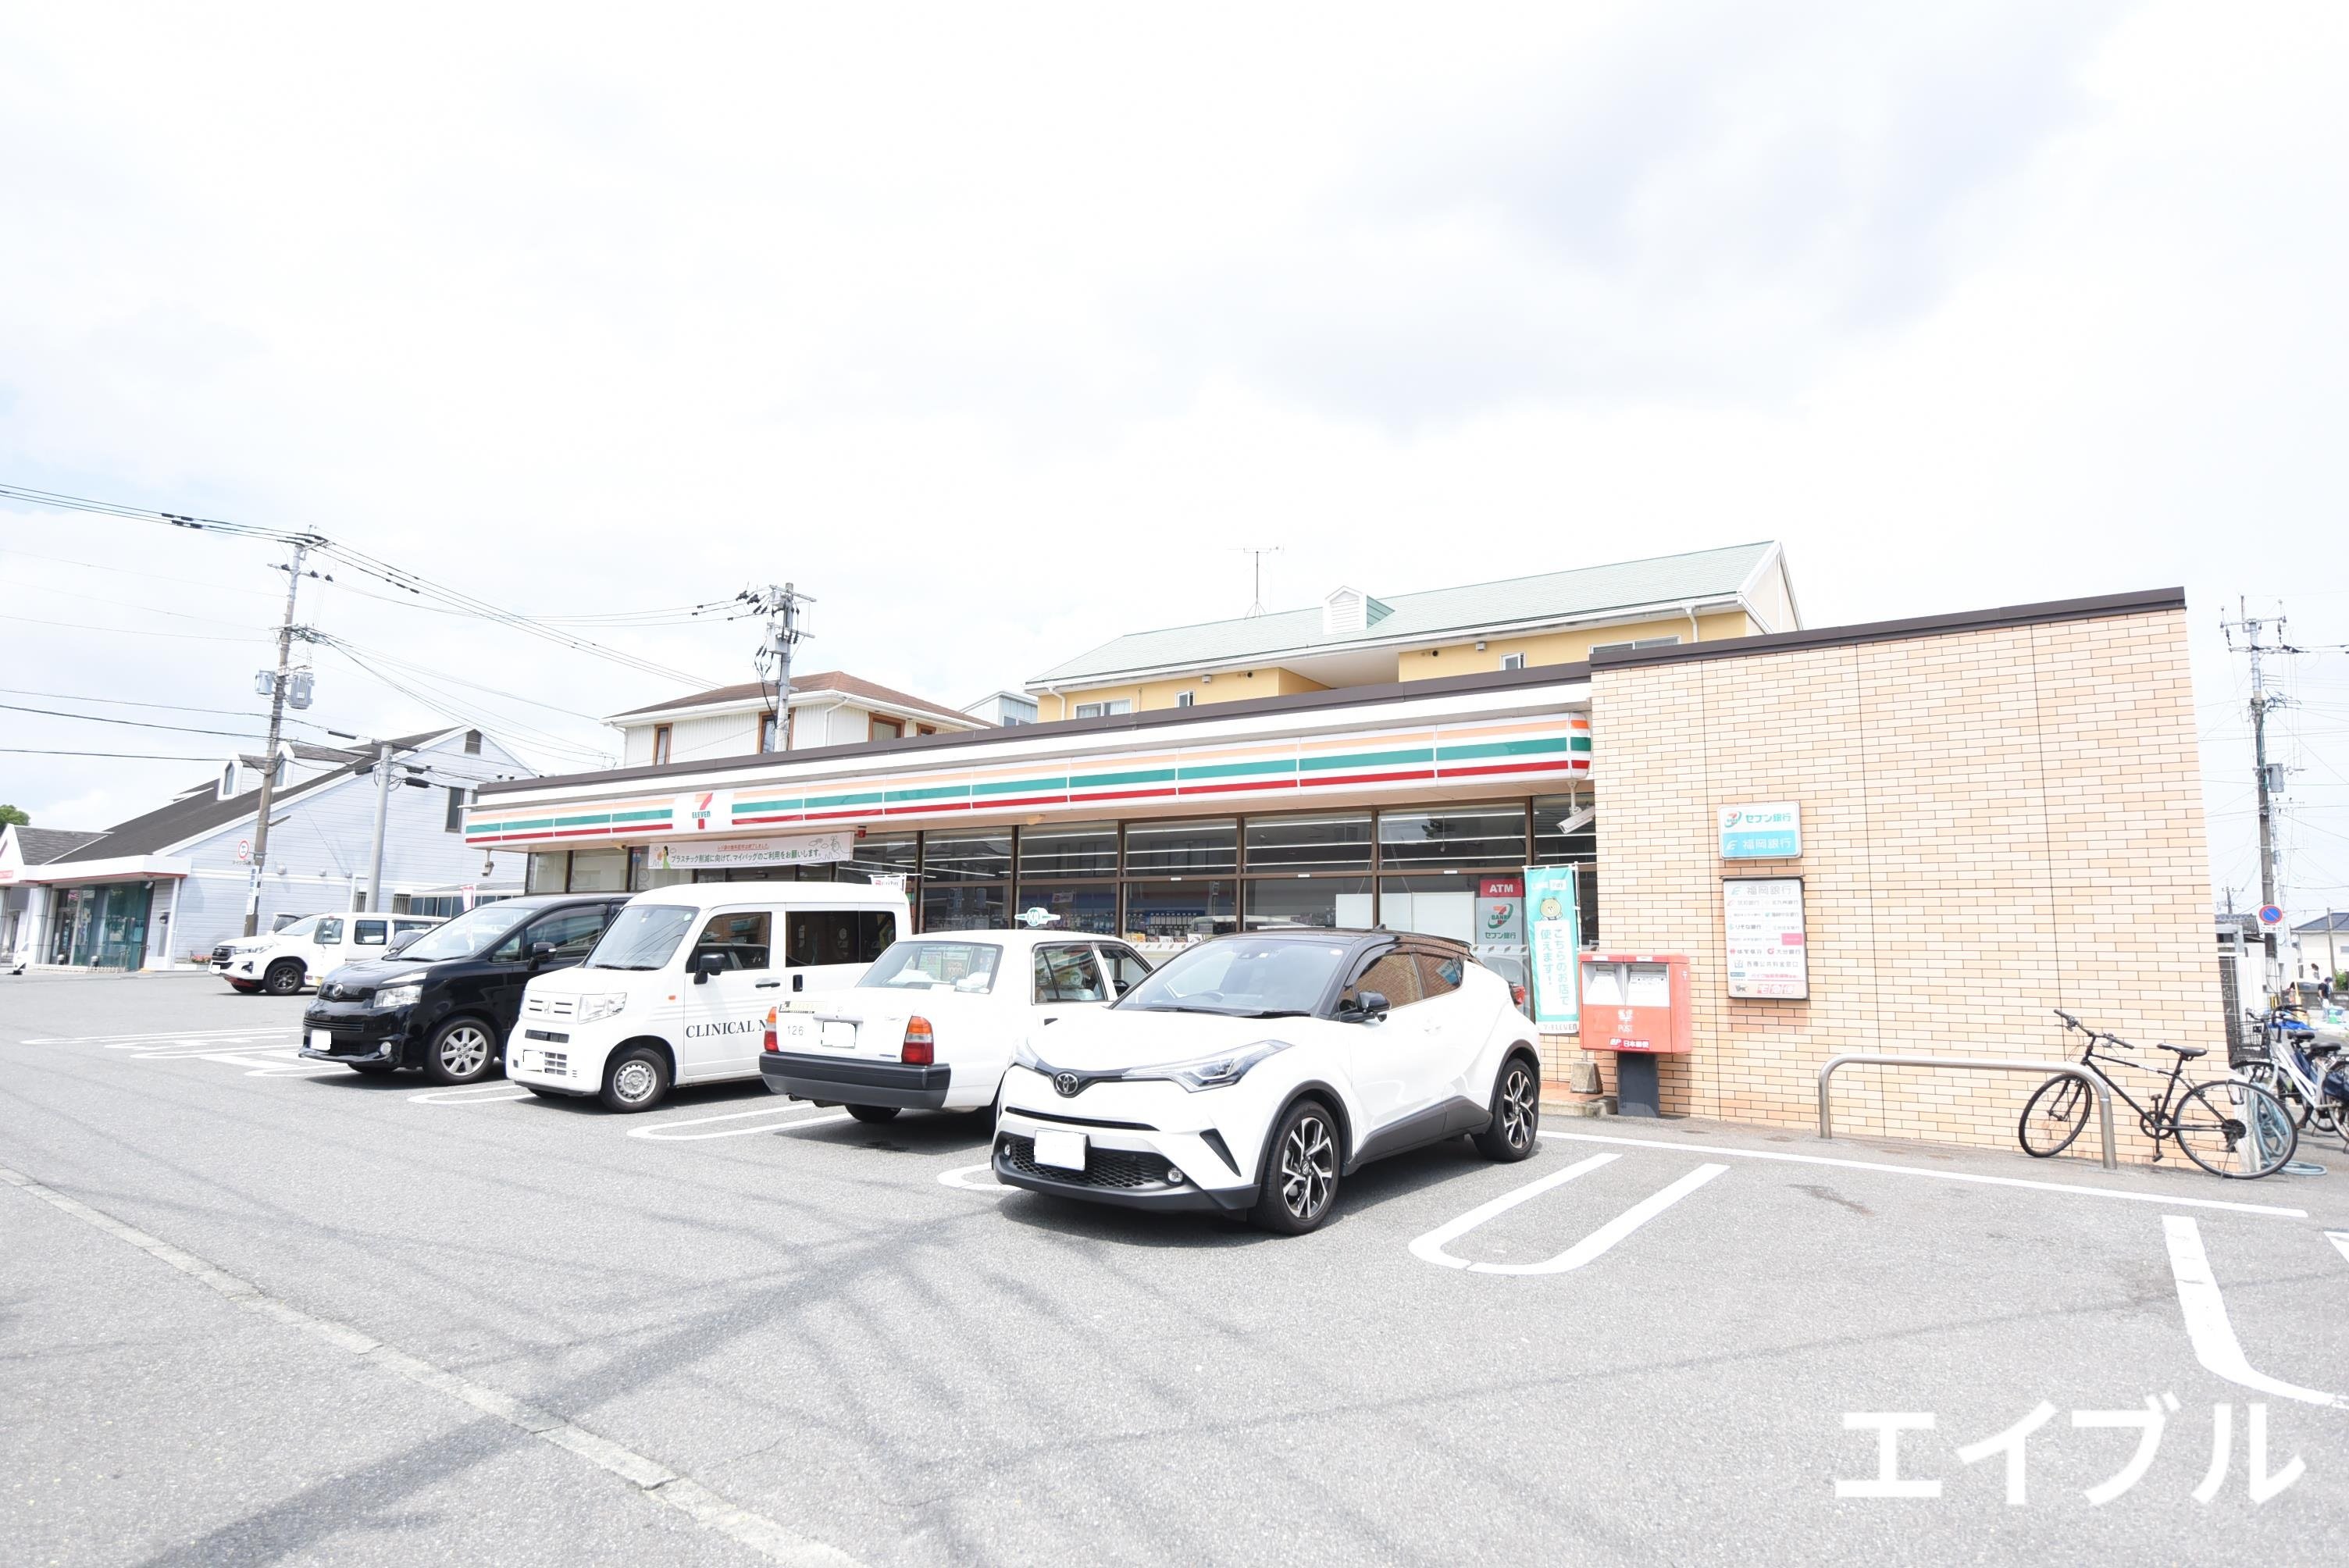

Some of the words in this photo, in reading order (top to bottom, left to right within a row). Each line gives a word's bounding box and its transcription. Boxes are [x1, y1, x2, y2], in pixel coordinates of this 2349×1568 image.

[1745, 813, 1791, 823] セブン銀行
[1742, 837, 1792, 850] 福岡銀行
[671, 848, 822, 863] プラスチック削減に向けて、マイバッグのご利用をお願いします。
[1489, 884, 1513, 893] ATM
[1746, 886, 1792, 895] 福岡銀行
[1553, 928, 1570, 1006] こちらのお店で
[686, 1020, 755, 1039] CLINICAL
[786, 1026, 804, 1036] 126
[1617, 1025, 1632, 1033] POST
